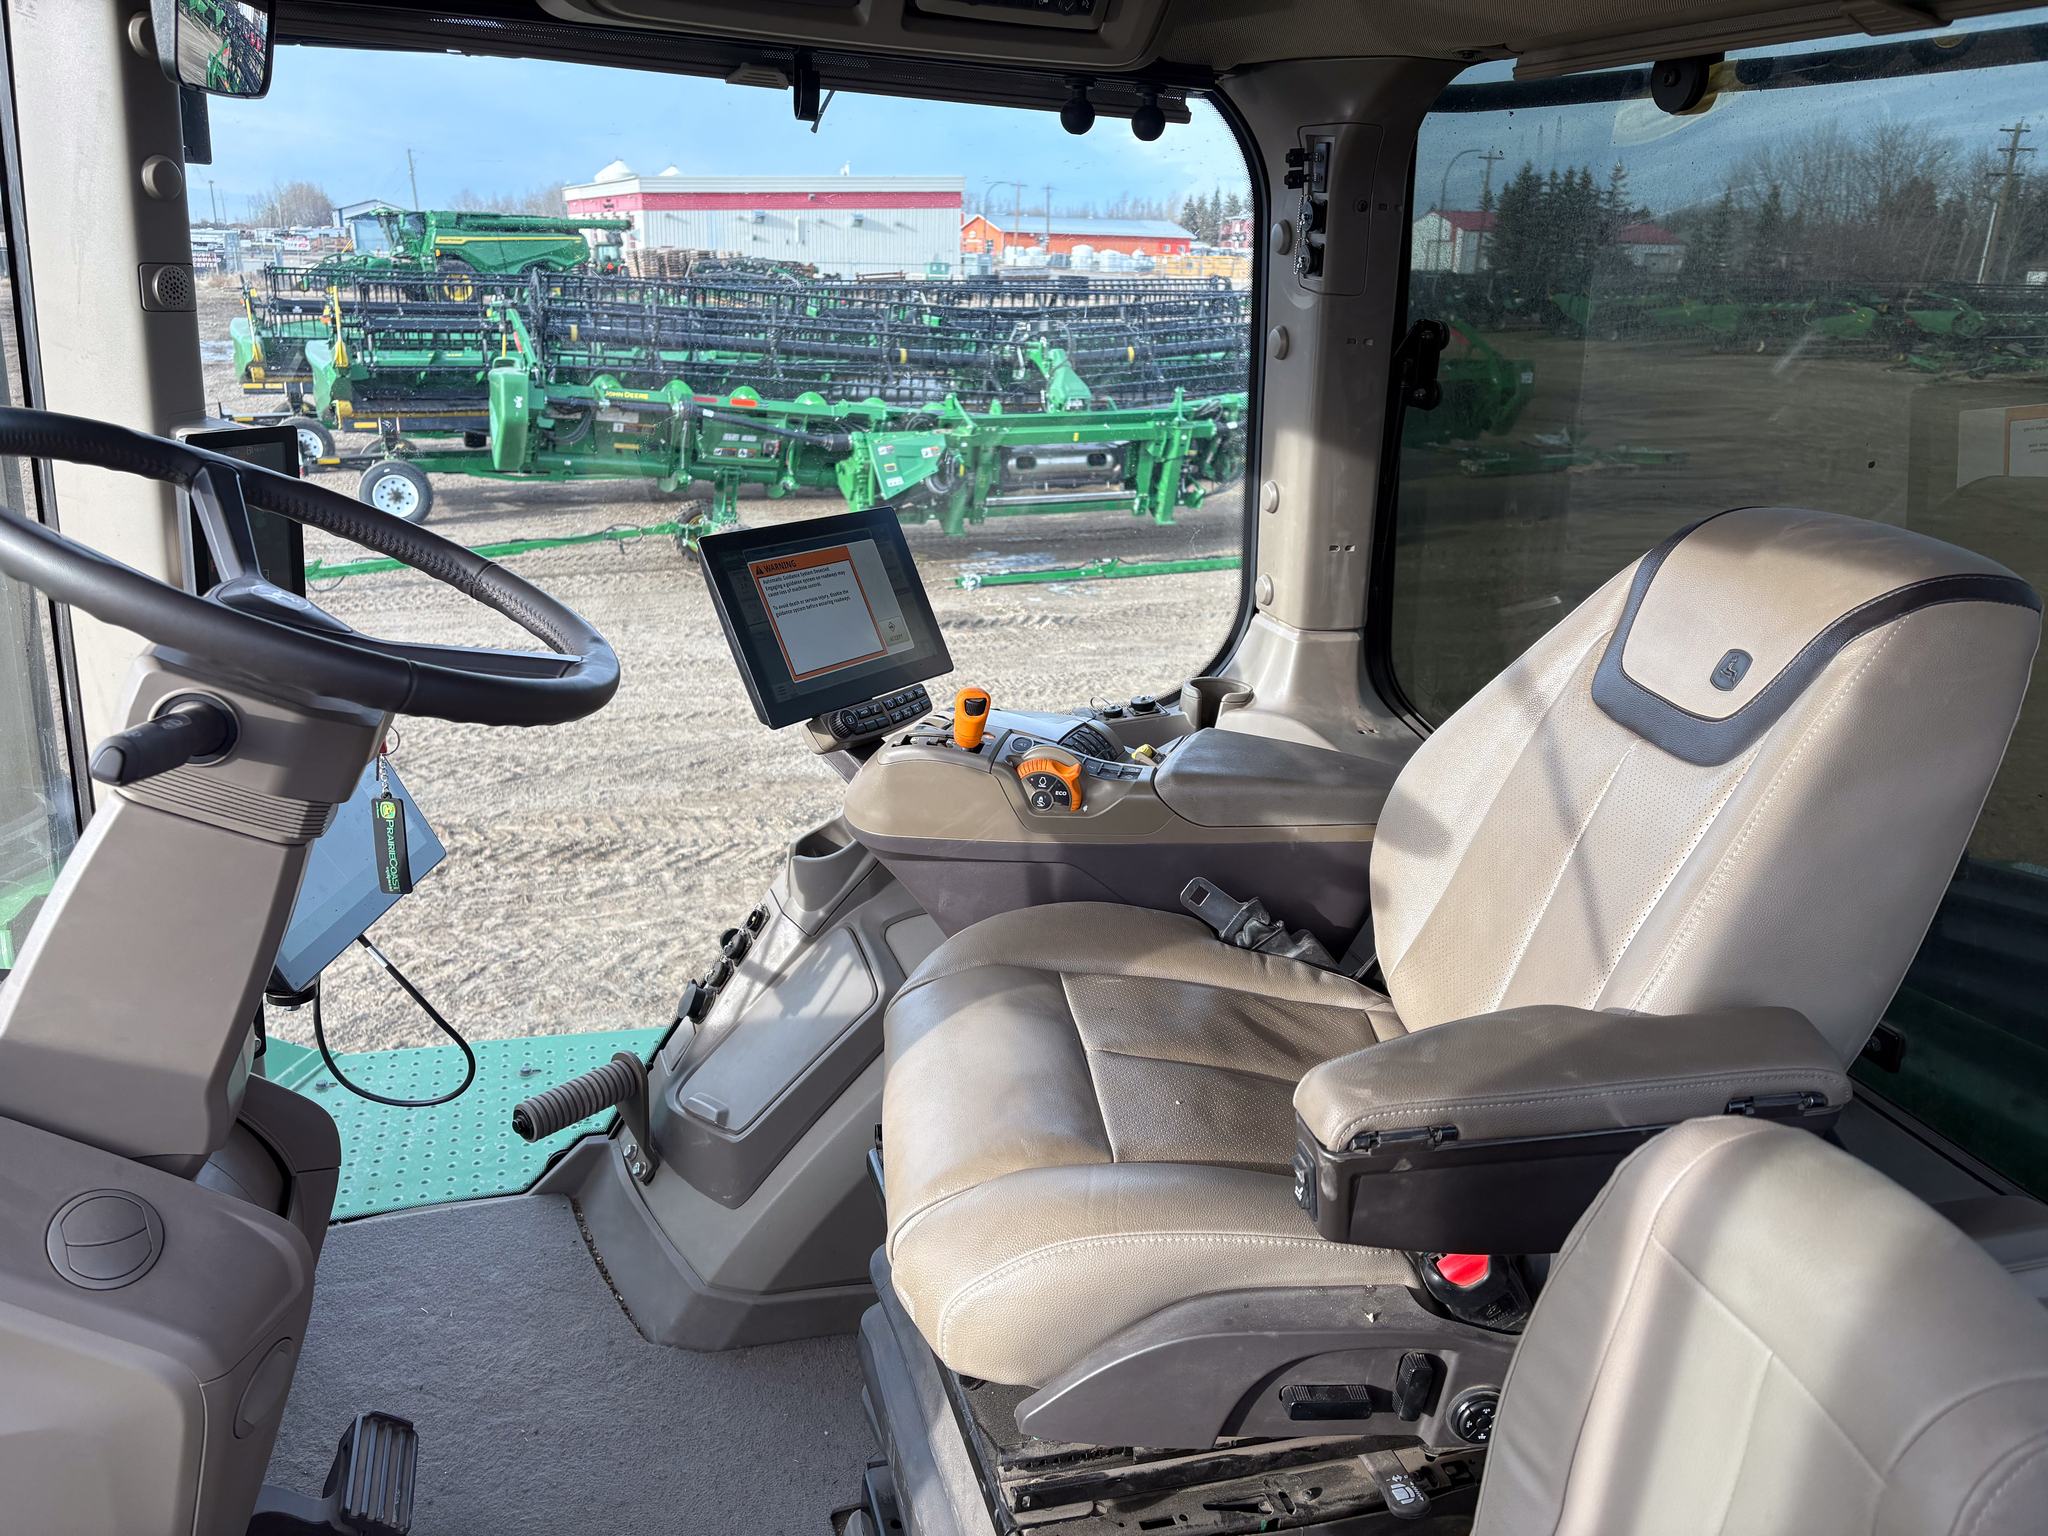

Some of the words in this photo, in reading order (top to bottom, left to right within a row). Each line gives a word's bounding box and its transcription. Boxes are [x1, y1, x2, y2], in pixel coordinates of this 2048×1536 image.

[624, 392, 649, 400] DEERE
[764, 560, 796, 572] WARNING
[765, 584, 784, 592] Engaging
[776, 610, 793, 618] guidance
[386, 820, 400, 892] PRAIRIECOAST
